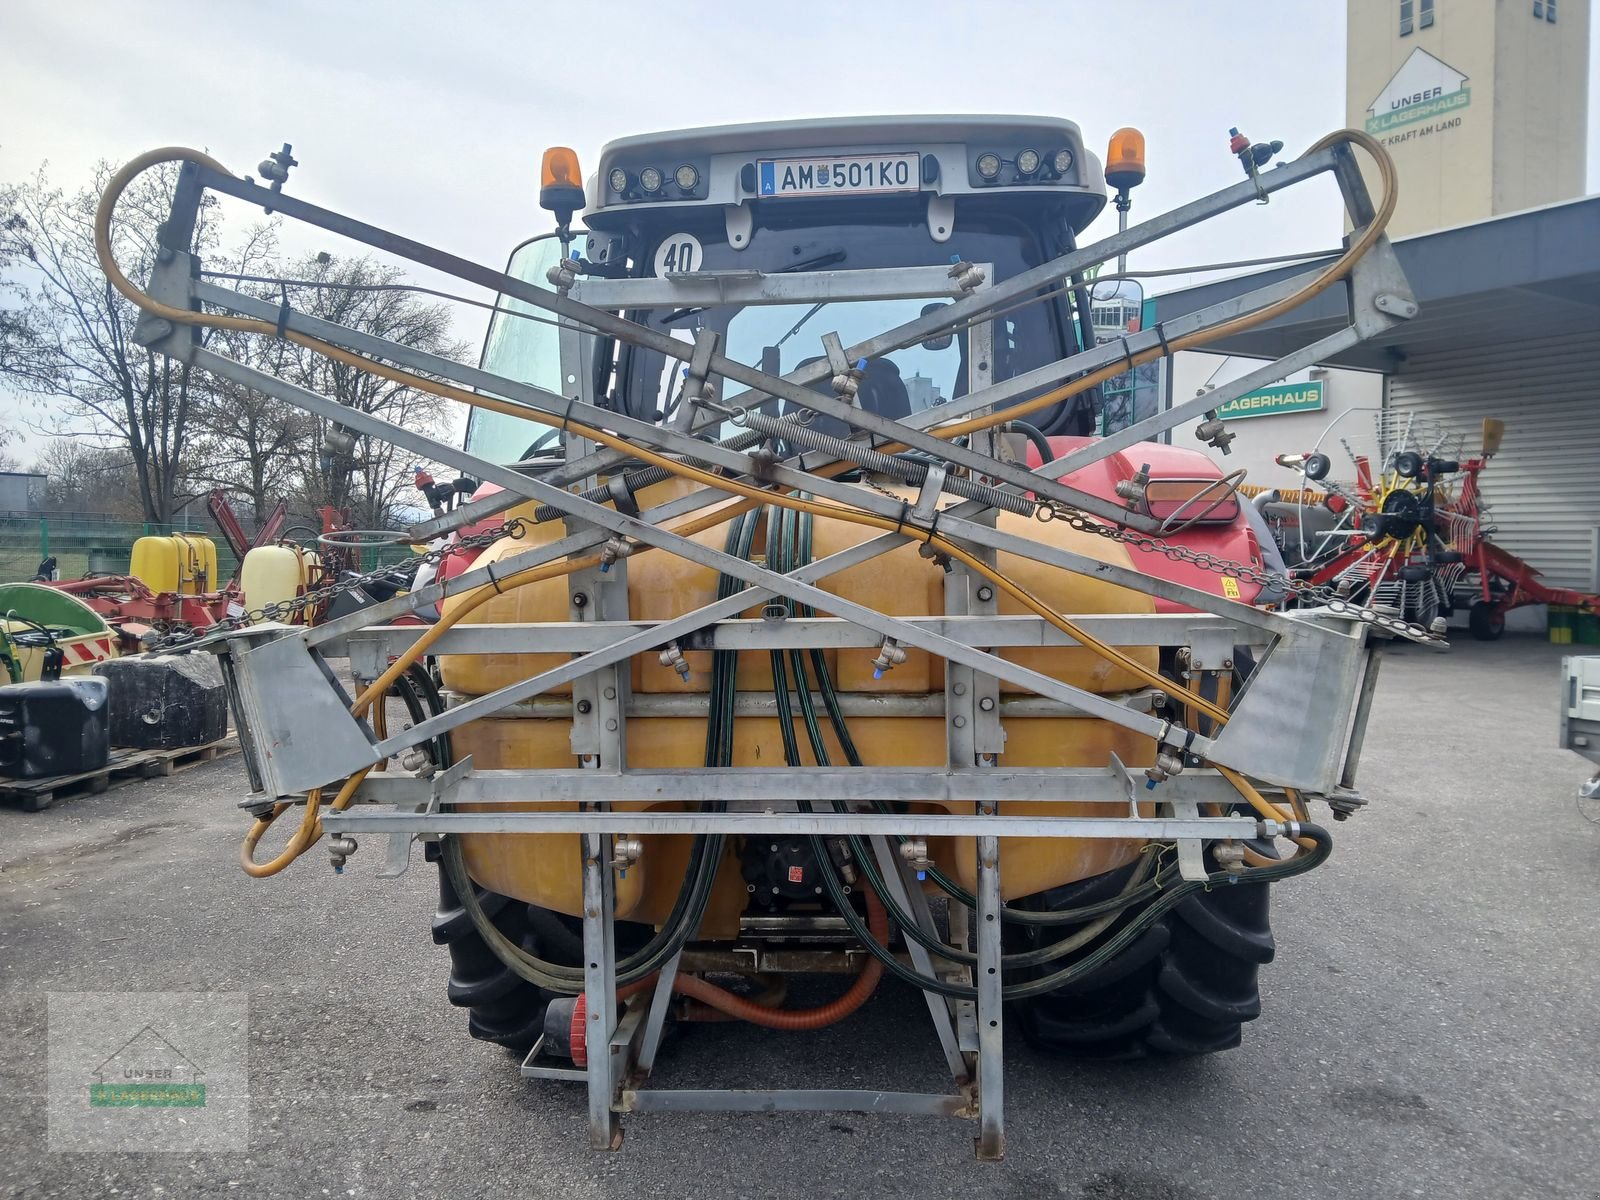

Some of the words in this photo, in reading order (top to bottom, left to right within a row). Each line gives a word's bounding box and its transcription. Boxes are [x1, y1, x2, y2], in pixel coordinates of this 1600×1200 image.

[1381, 92, 1468, 128] LAGERHAUS
[1391, 86, 1442, 110] UNSER
[1388, 129, 1417, 146] KRAFT
[1419, 125, 1434, 137] AM
[1435, 117, 1462, 132] LAND
[781, 165, 813, 190] AM
[663, 242, 693, 273] 40
[1221, 390, 1319, 412] LAGERHAUS
